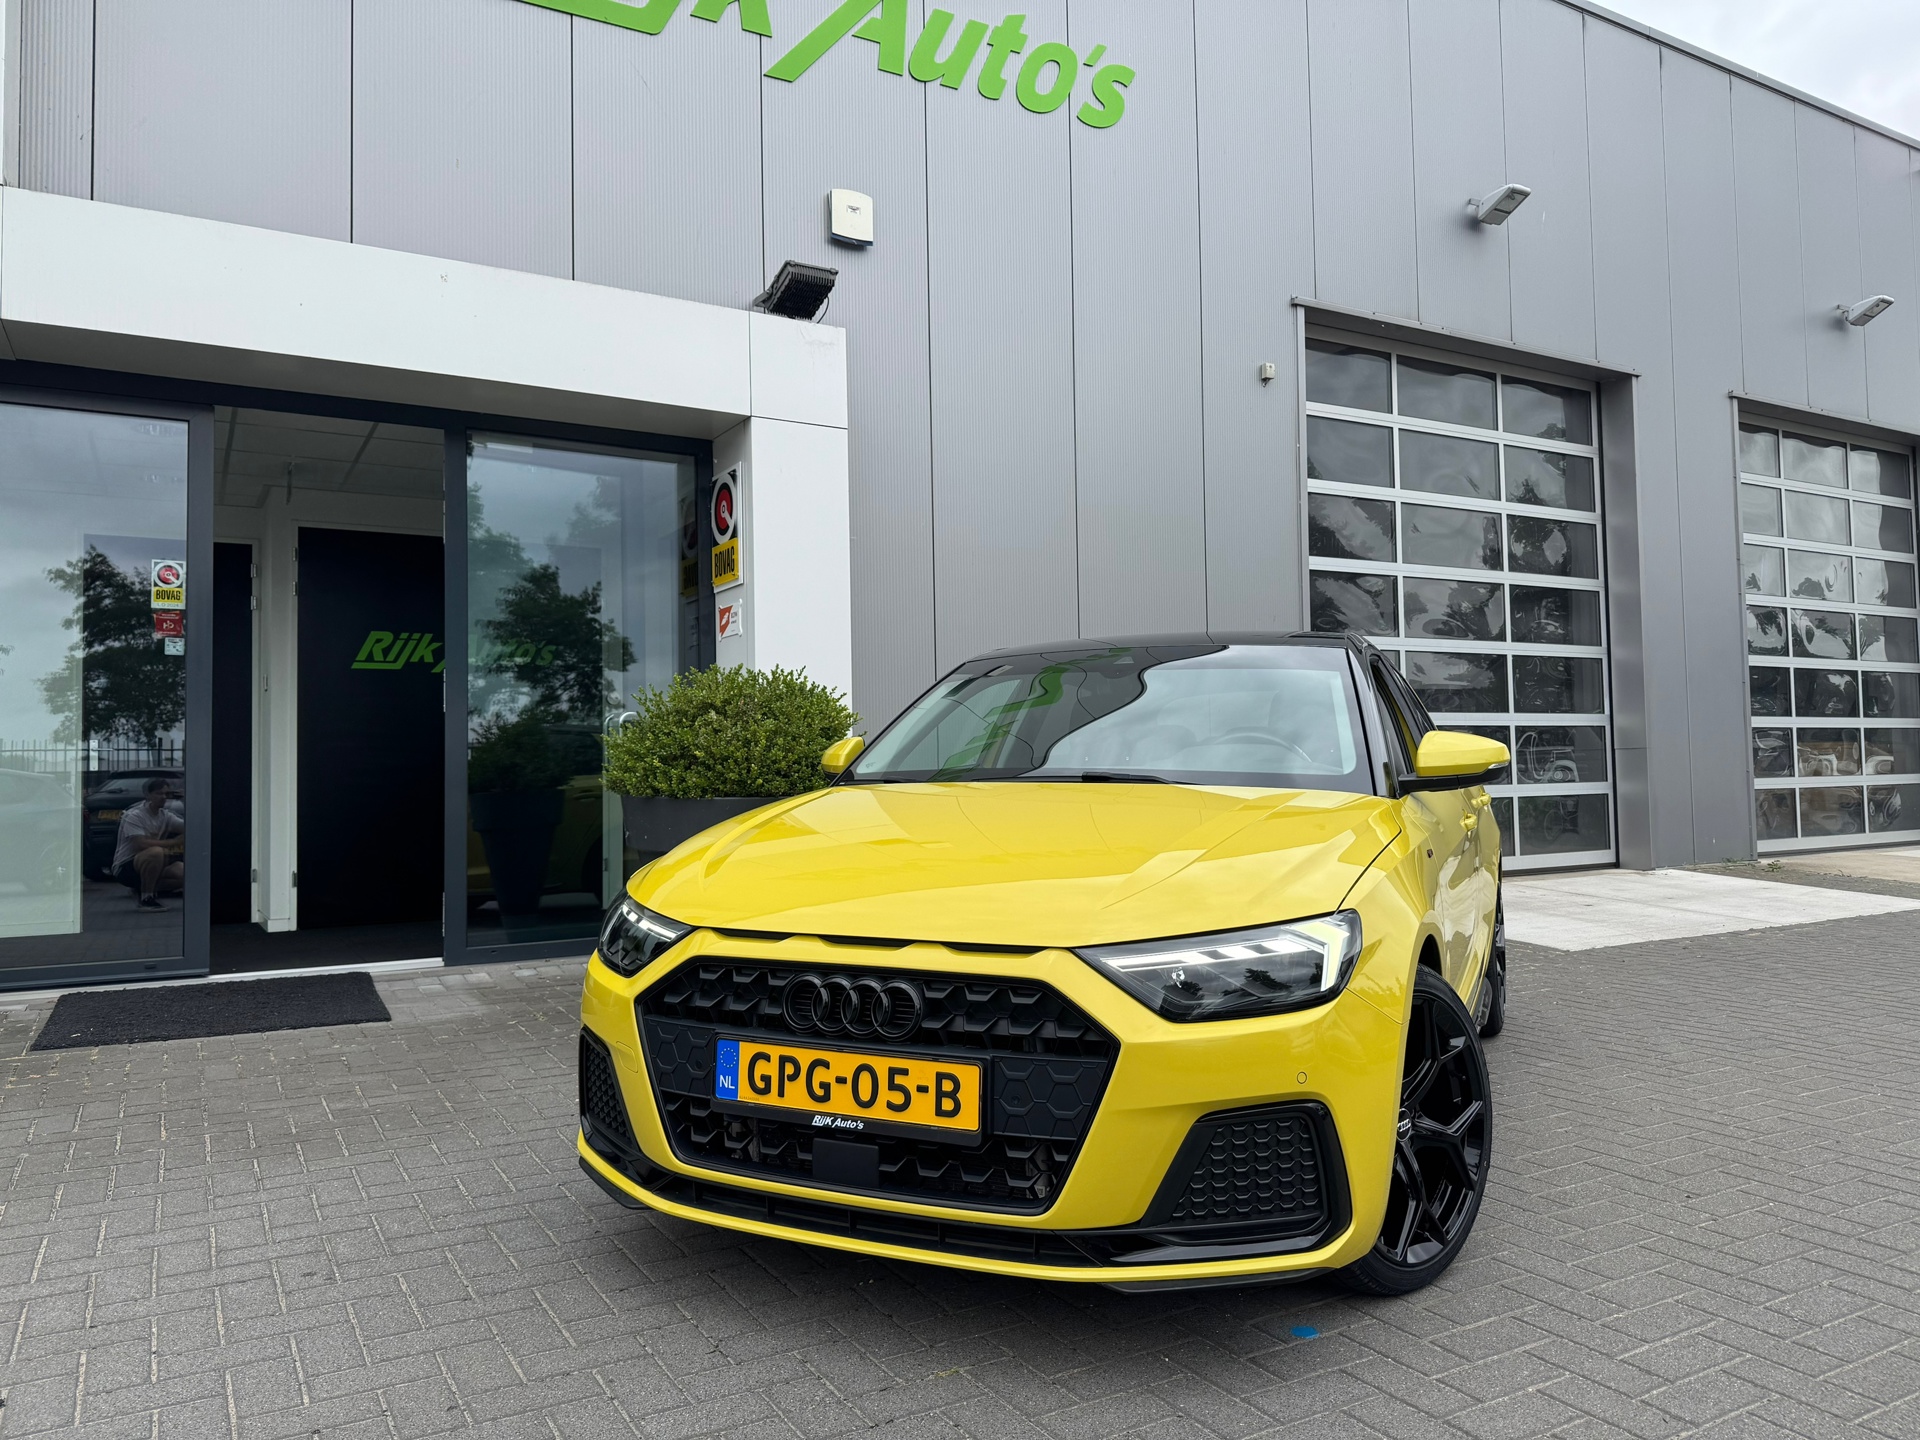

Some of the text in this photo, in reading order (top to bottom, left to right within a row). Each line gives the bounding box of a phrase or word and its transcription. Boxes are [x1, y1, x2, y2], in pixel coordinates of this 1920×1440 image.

[715, 546, 735, 578] BOVAG
[155, 589, 181, 601] BOVAG
[351, 630, 443, 670] Rijk
[719, 1074, 735, 1090] NL
[747, 1051, 961, 1118] GPG-05-B
[831, 1118, 865, 1130] Auto's
